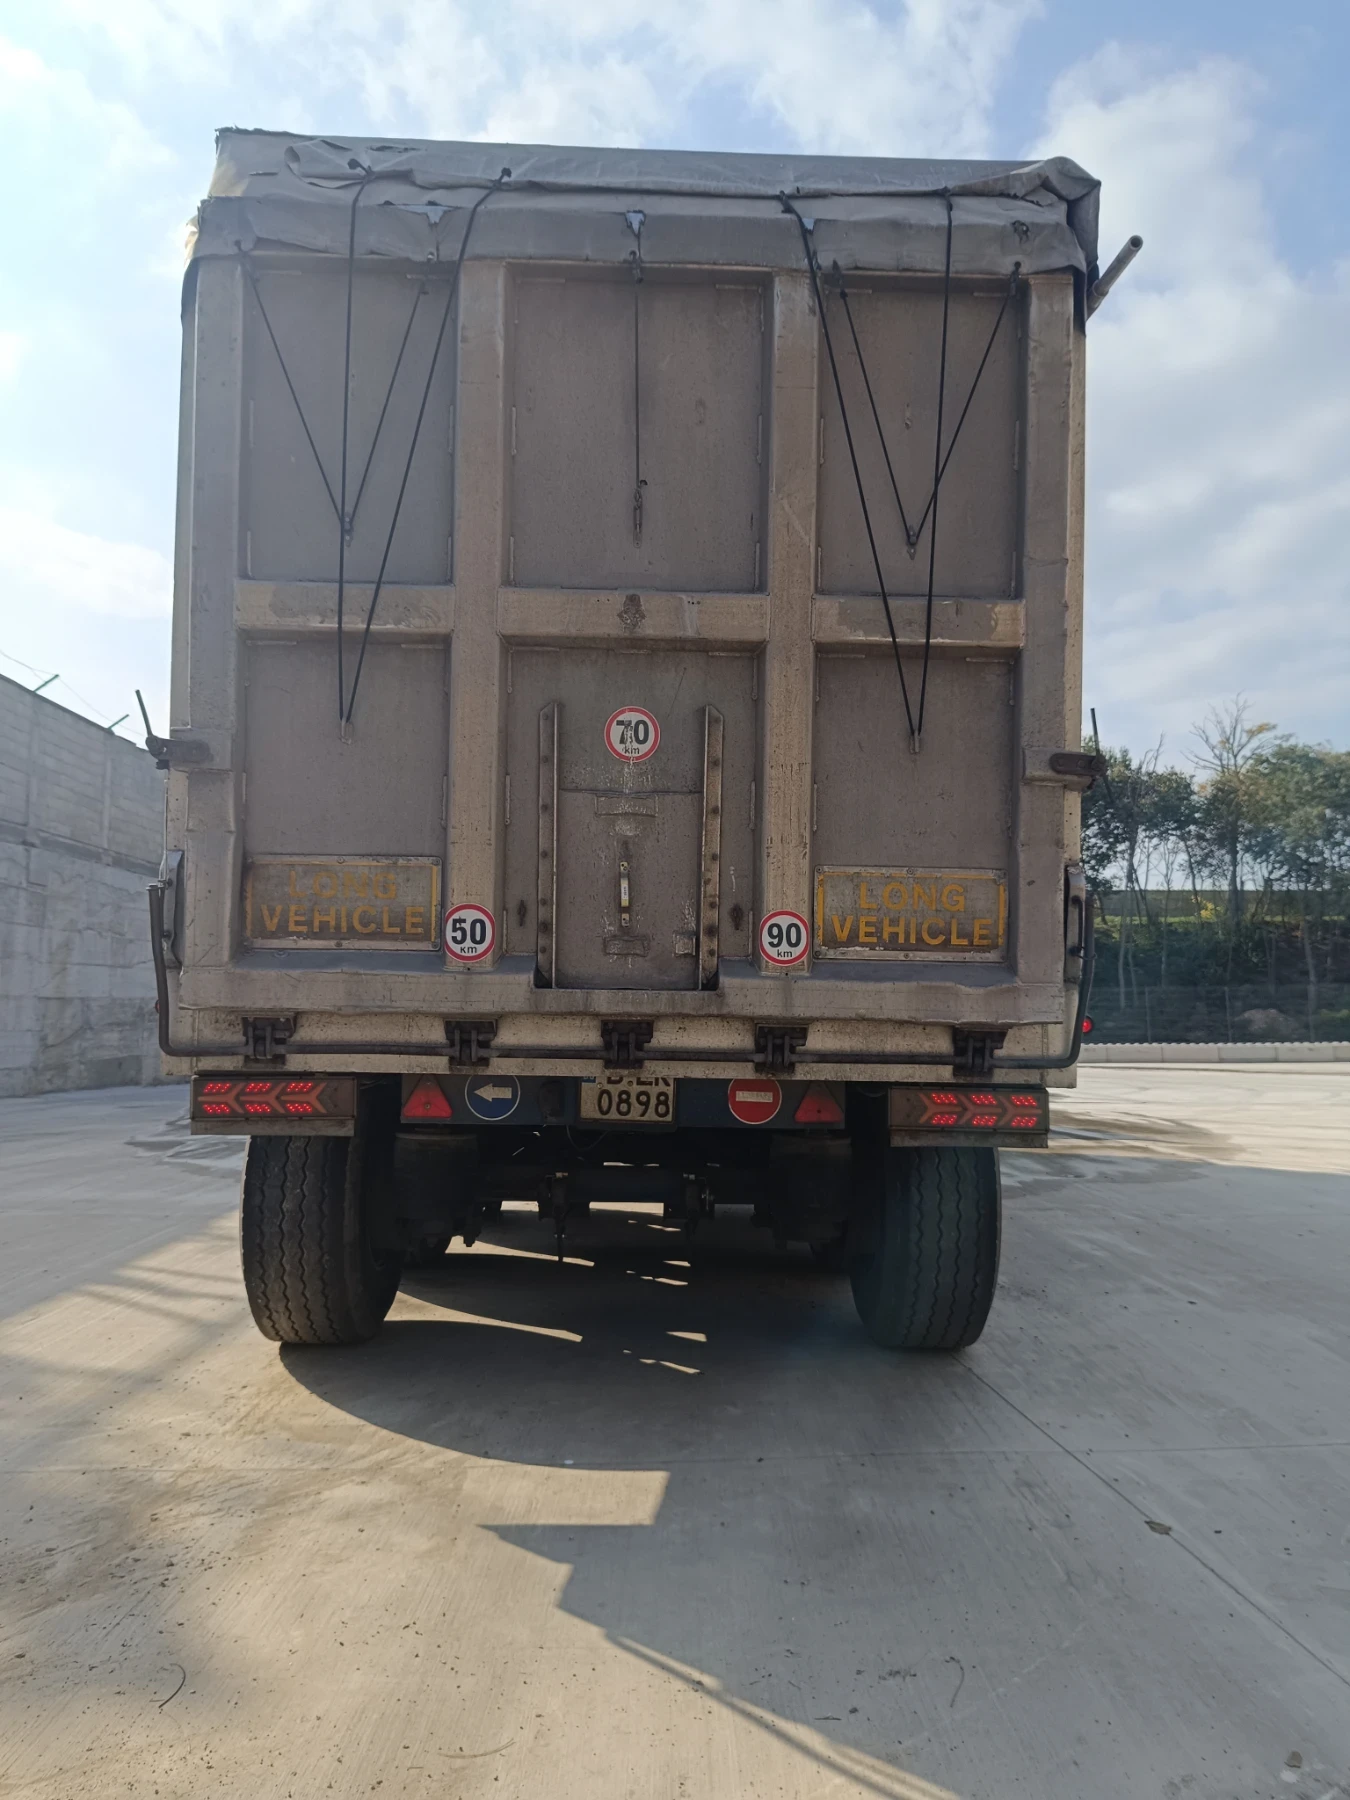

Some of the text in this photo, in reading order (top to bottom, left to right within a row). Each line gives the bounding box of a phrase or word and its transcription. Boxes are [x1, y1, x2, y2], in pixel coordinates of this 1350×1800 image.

[616, 720, 649, 745] 70
[289, 870, 398, 899] LONG
[859, 882, 966, 912] LONG
[260, 903, 425, 934] VEHICLE
[451, 917, 487, 945] 50
[831, 914, 992, 946] VEHICLE
[767, 922, 802, 948] 90
[777, 949, 793, 958] km
[597, 1088, 671, 1118] 0898
